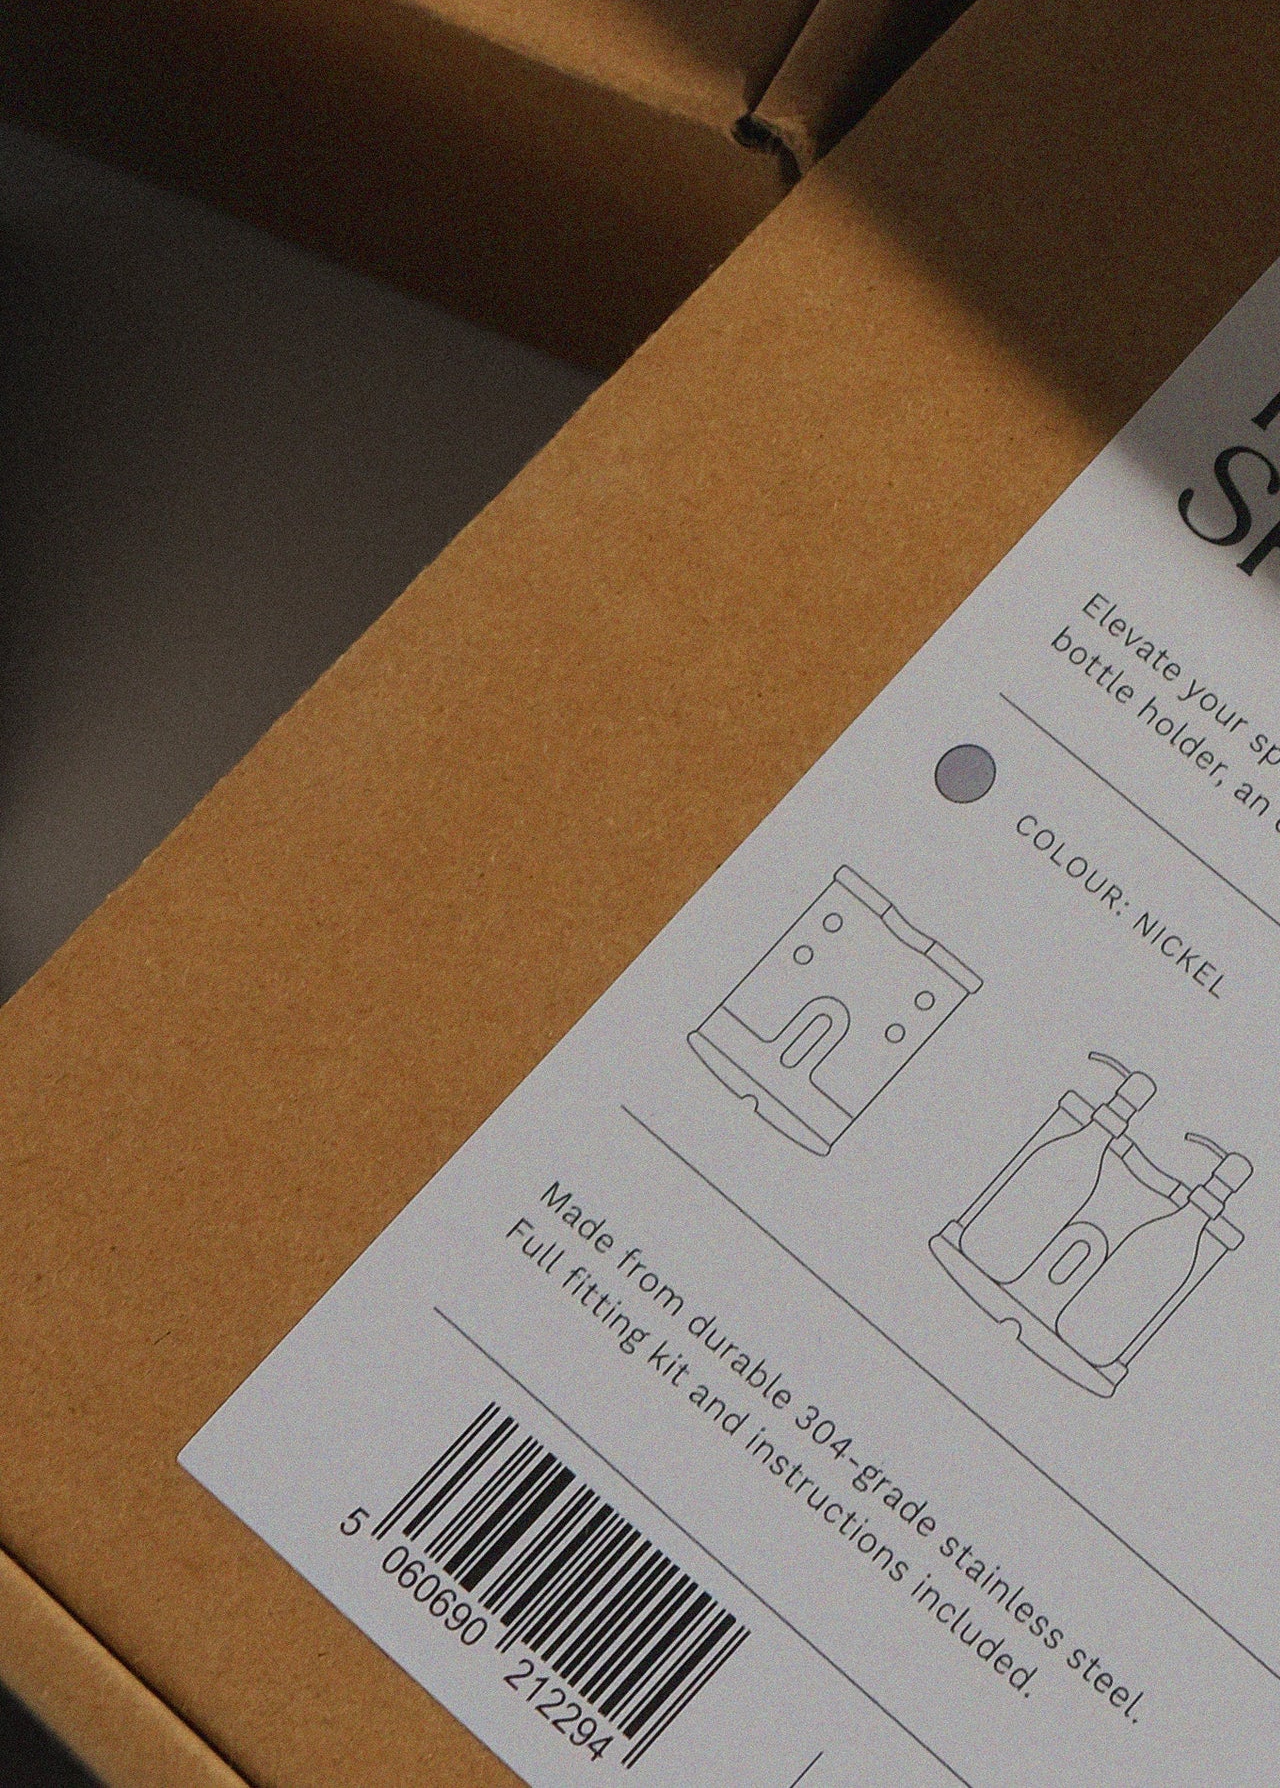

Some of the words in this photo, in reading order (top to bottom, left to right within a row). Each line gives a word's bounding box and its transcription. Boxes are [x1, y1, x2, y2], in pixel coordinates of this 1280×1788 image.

[1050, 624, 1135, 705] bottle
[1136, 695, 1229, 788] holder,
[1232, 781, 1271, 818] an
[1081, 591, 1182, 682] Elevate
[1176, 678, 1250, 733] your
[1015, 813, 1130, 917] COLOUR:
[1131, 910, 1225, 1000] NICKEL
[504, 1216, 566, 1276] Full
[561, 1265, 652, 1356] fitting
[646, 1339, 690, 1388] kit
[687, 1383, 751, 1437] and
[744, 1426, 910, 1583] instructions
[910, 1572, 1039, 1700] included.
[539, 1179, 615, 1254] Made
[616, 1246, 685, 1318] from
[687, 1314, 793, 1410] durable
[794, 1404, 937, 1538] 304-grade
[938, 1535, 1065, 1650] stainless
[1065, 1647, 1145, 1725] steel.
[339, 1506, 371, 1540] 5
[381, 1545, 488, 1647] 060690
[502, 1658, 614, 1763] 212294
